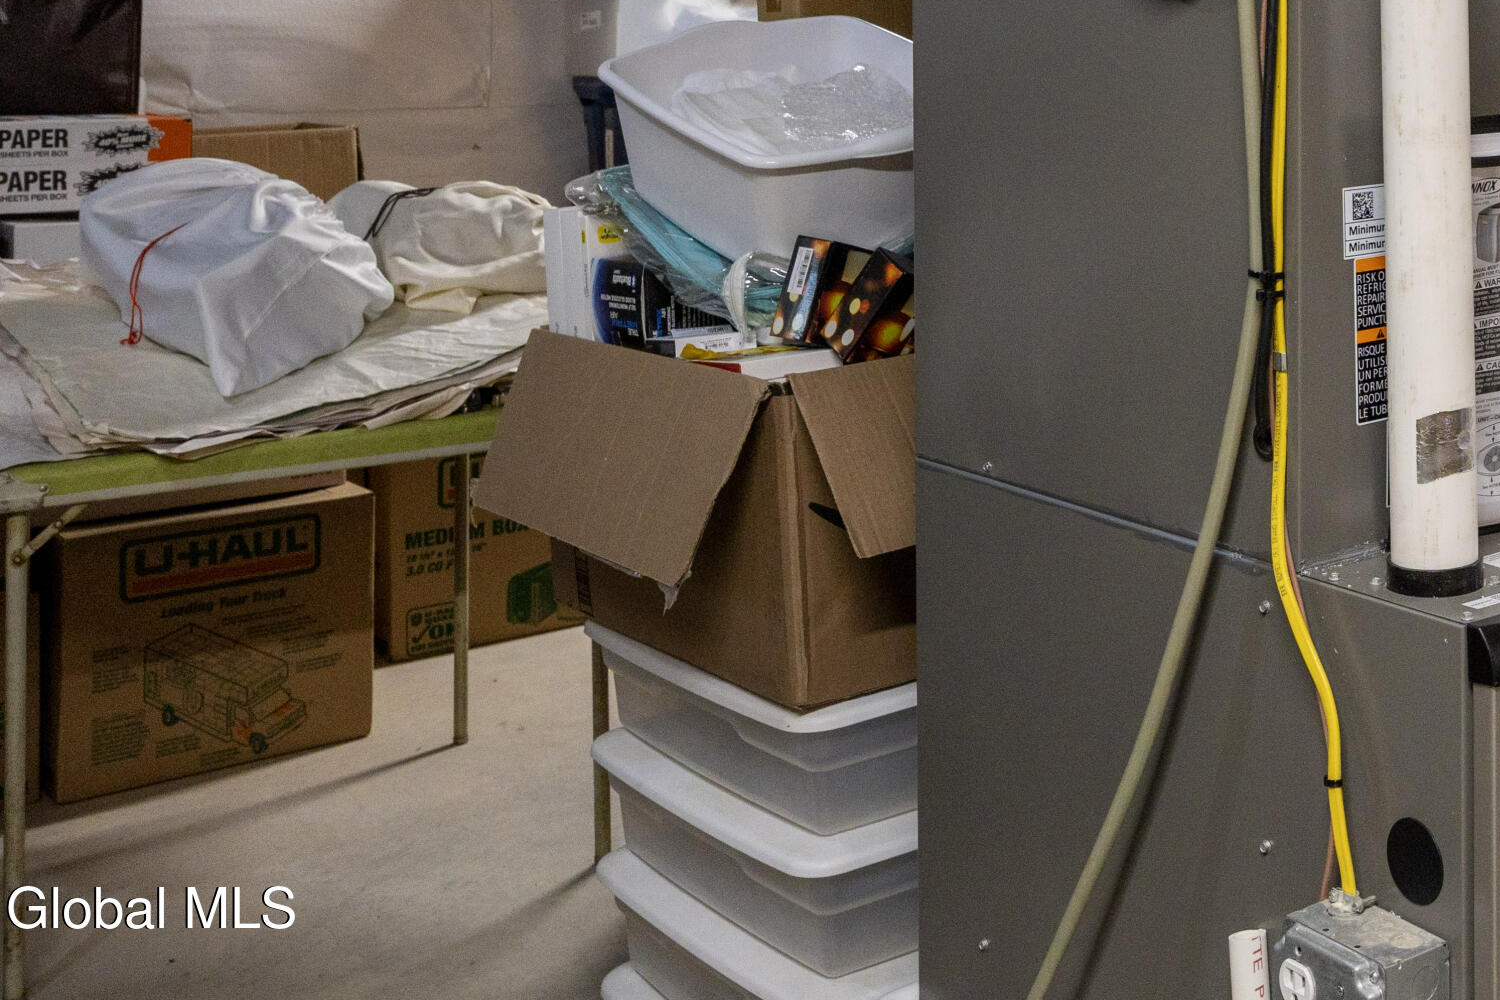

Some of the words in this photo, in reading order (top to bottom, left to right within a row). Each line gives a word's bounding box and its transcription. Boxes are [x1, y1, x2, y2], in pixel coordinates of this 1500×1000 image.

[0, 128, 69, 149] PAPER
[0, 170, 67, 193] PAPER
[1357, 272, 1376, 284] RISK
[1358, 292, 1385, 305] REPAIR
[1358, 303, 1386, 317] SERVIC
[1359, 343, 1385, 357] RISQUE
[1359, 371, 1372, 381] UN
[1360, 408, 1368, 419] LE
[406, 522, 485, 550] MEDIM
[407, 565, 424, 576] 3.0
[161, 601, 215, 618] Loading
[220, 595, 248, 608] Your
[253, 588, 287, 602] Truck
